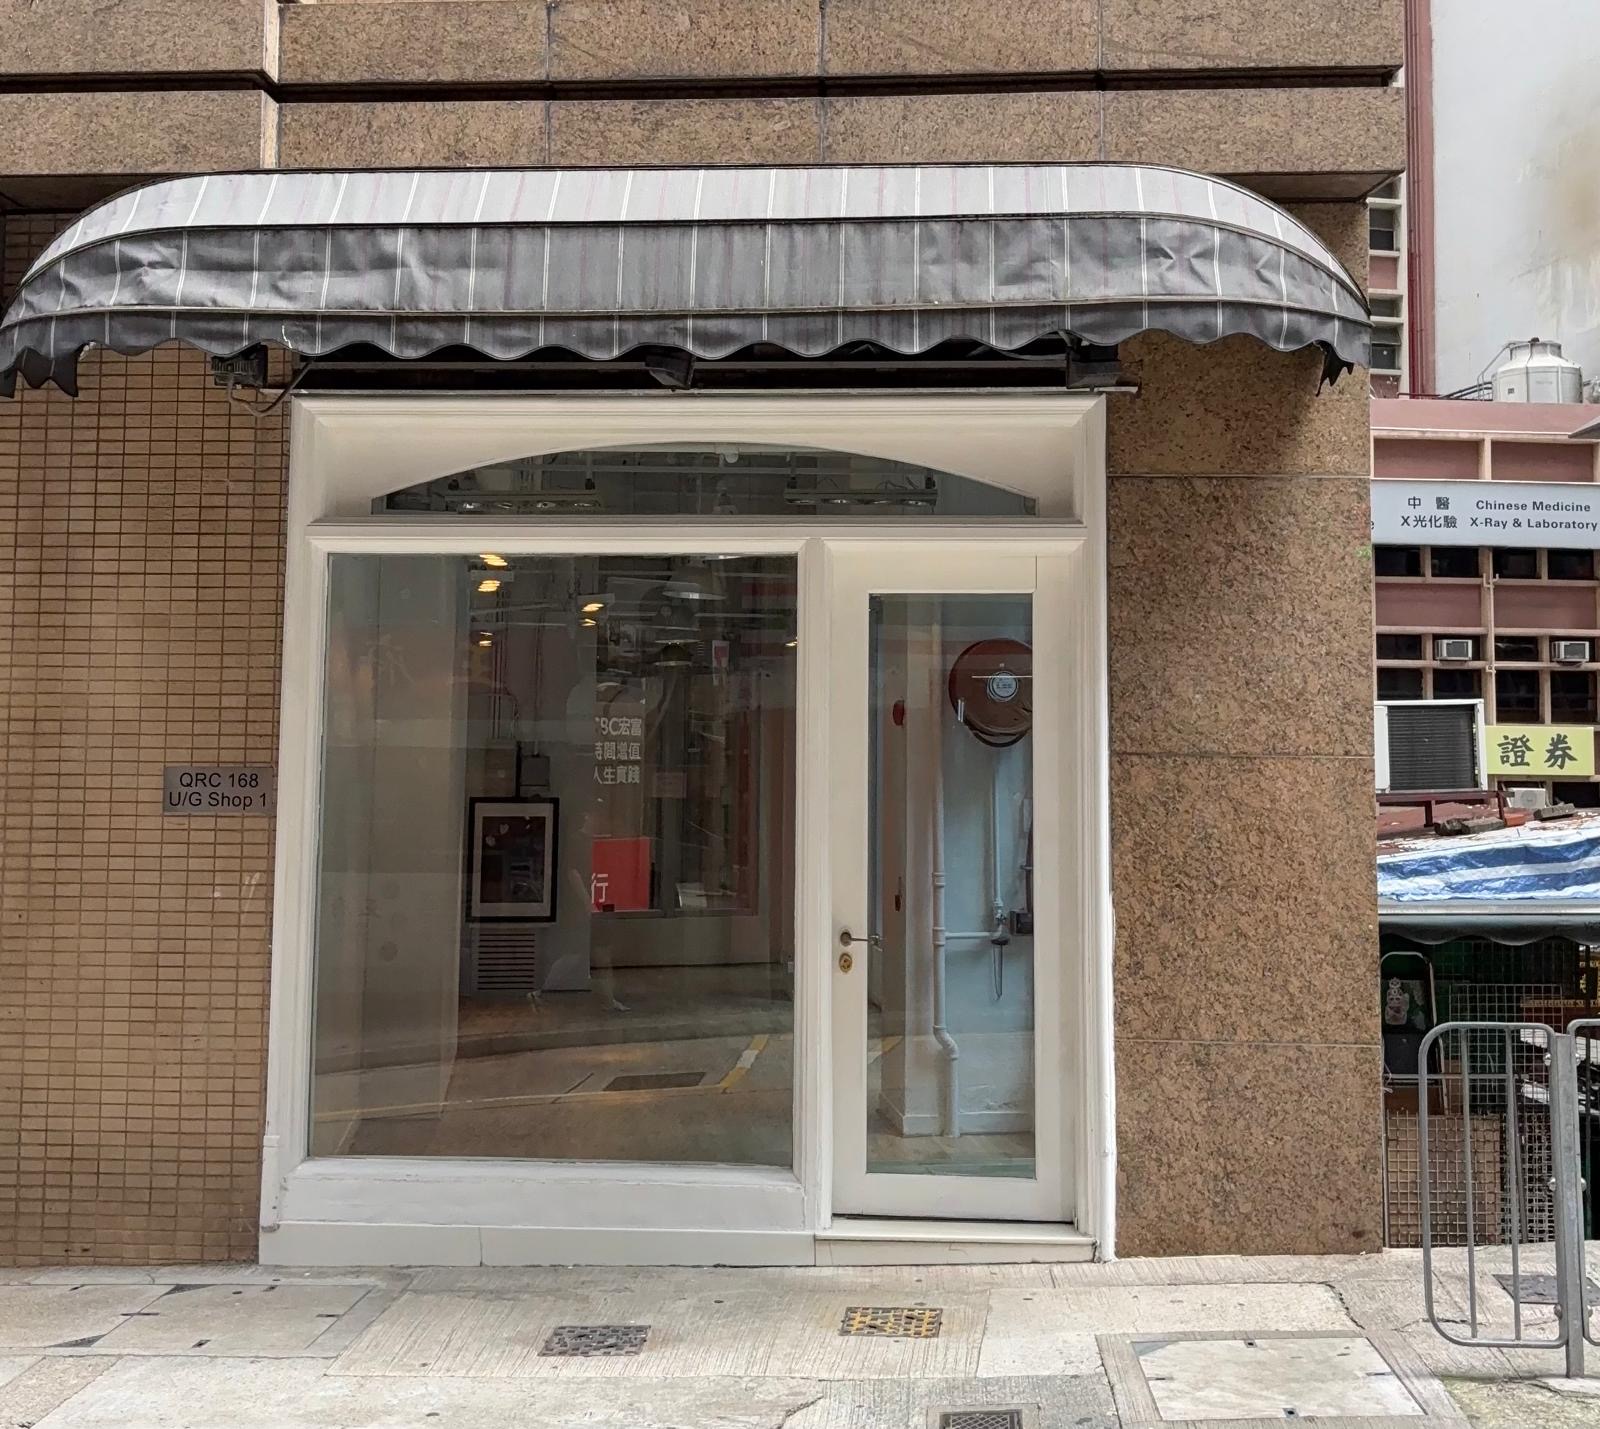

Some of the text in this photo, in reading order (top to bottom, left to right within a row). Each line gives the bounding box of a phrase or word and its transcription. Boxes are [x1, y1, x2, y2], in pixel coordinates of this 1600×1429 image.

[1408, 496, 1450, 510] 中醫
[1475, 500, 1591, 512] Chinese Medicine
[1401, 515, 1458, 528] X光化驗
[1469, 517, 1598, 532] X-Ray & Laboratory
[1497, 733, 1578, 770] 證券
[179, 772, 259, 788] QRC 168
[169, 791, 266, 810] U/G Shop 1
[591, 872, 609, 904] 行
